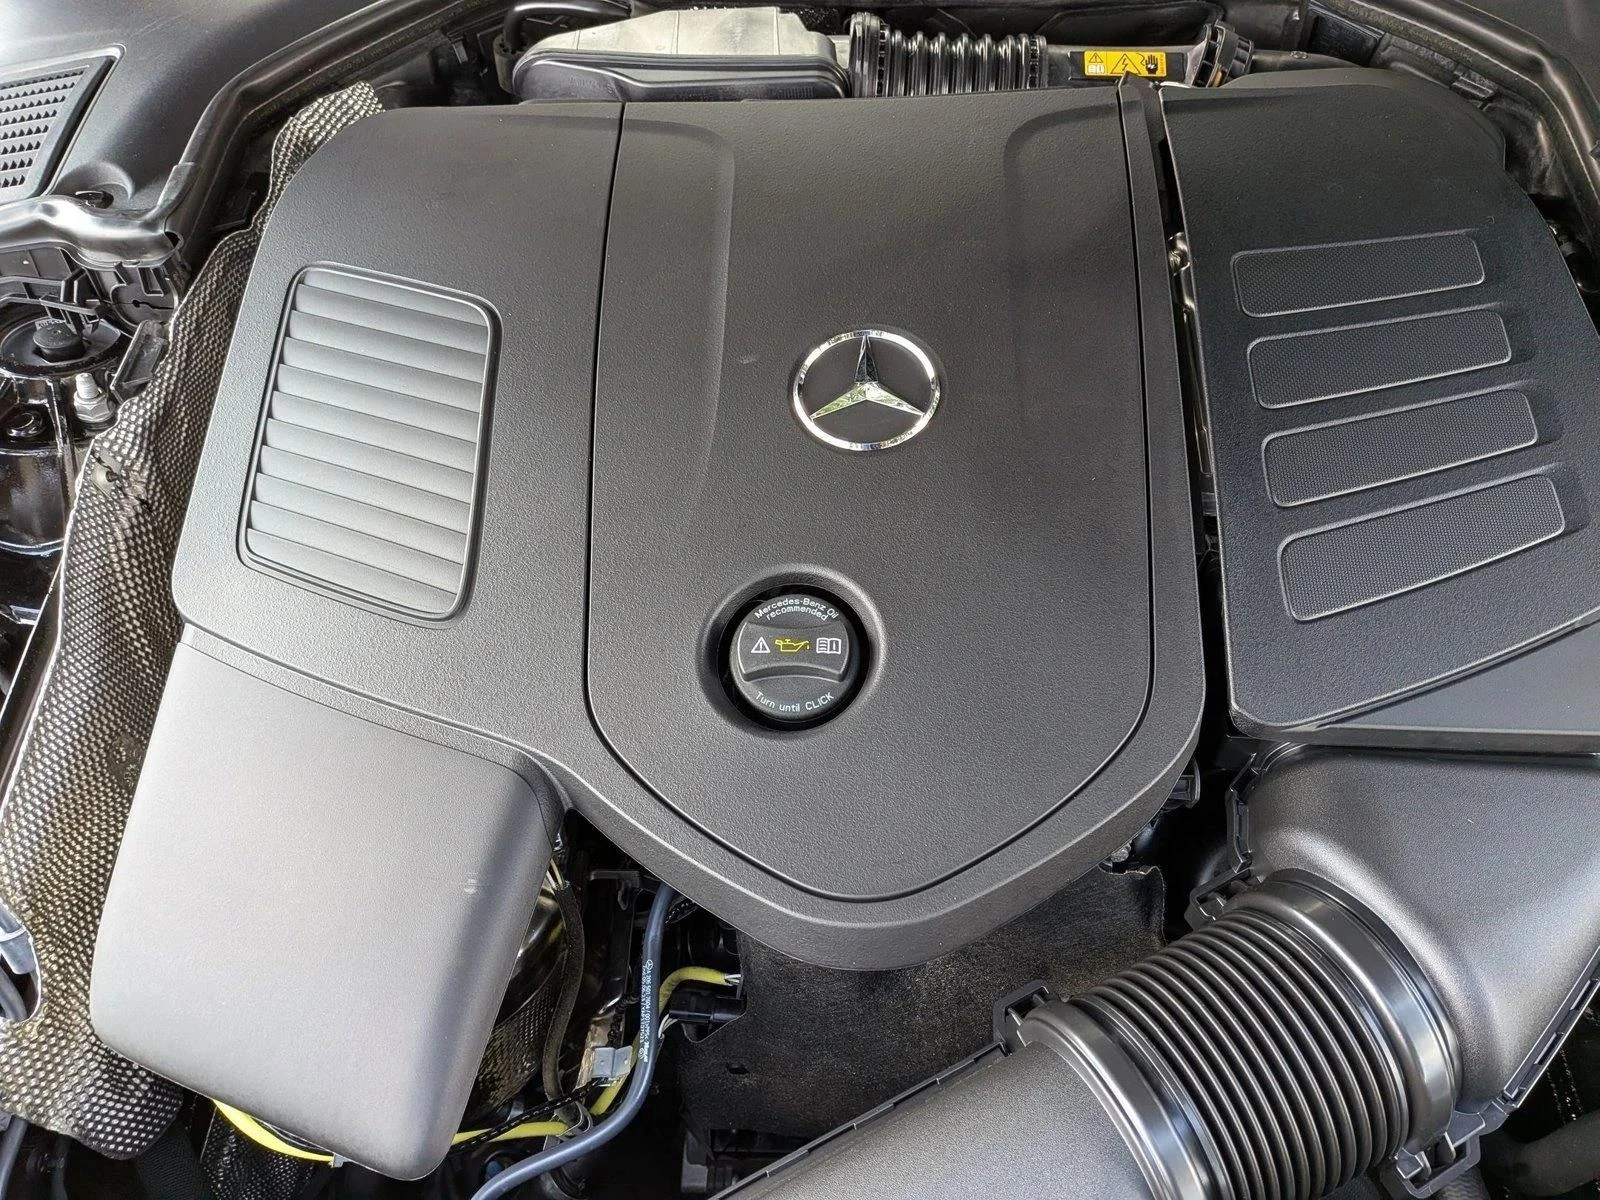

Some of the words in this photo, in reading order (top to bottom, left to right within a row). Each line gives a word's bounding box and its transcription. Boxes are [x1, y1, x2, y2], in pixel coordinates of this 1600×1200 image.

[754, 598, 826, 619] Mercedes-Benz
[826, 607, 839, 619] Oil
[766, 605, 829, 621] recommended
[755, 691, 775, 709] Turn
[779, 703, 801, 712] until
[805, 691, 834, 711] CLICK
